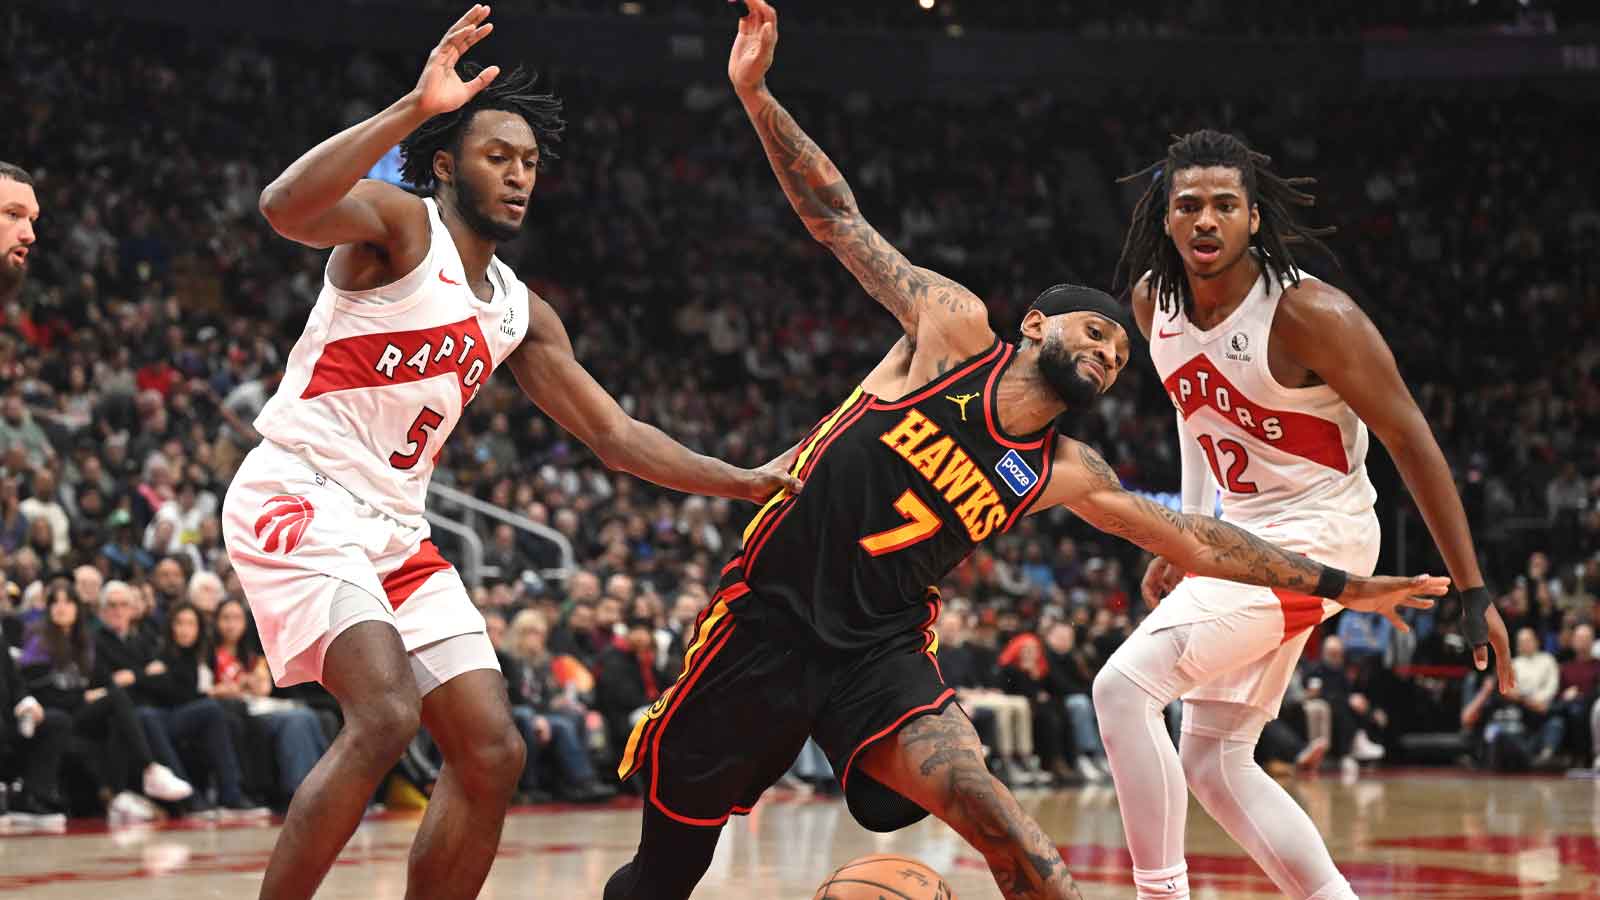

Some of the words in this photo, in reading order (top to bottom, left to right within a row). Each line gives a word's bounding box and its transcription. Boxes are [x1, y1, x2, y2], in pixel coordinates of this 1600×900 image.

[376, 334, 484, 408] RAPTO
[389, 406, 445, 470] 5
[1197, 434, 1258, 493] 12
[879, 407, 1008, 543] HAWKS
[1001, 457, 1029, 487] paze
[858, 488, 943, 557] 7
